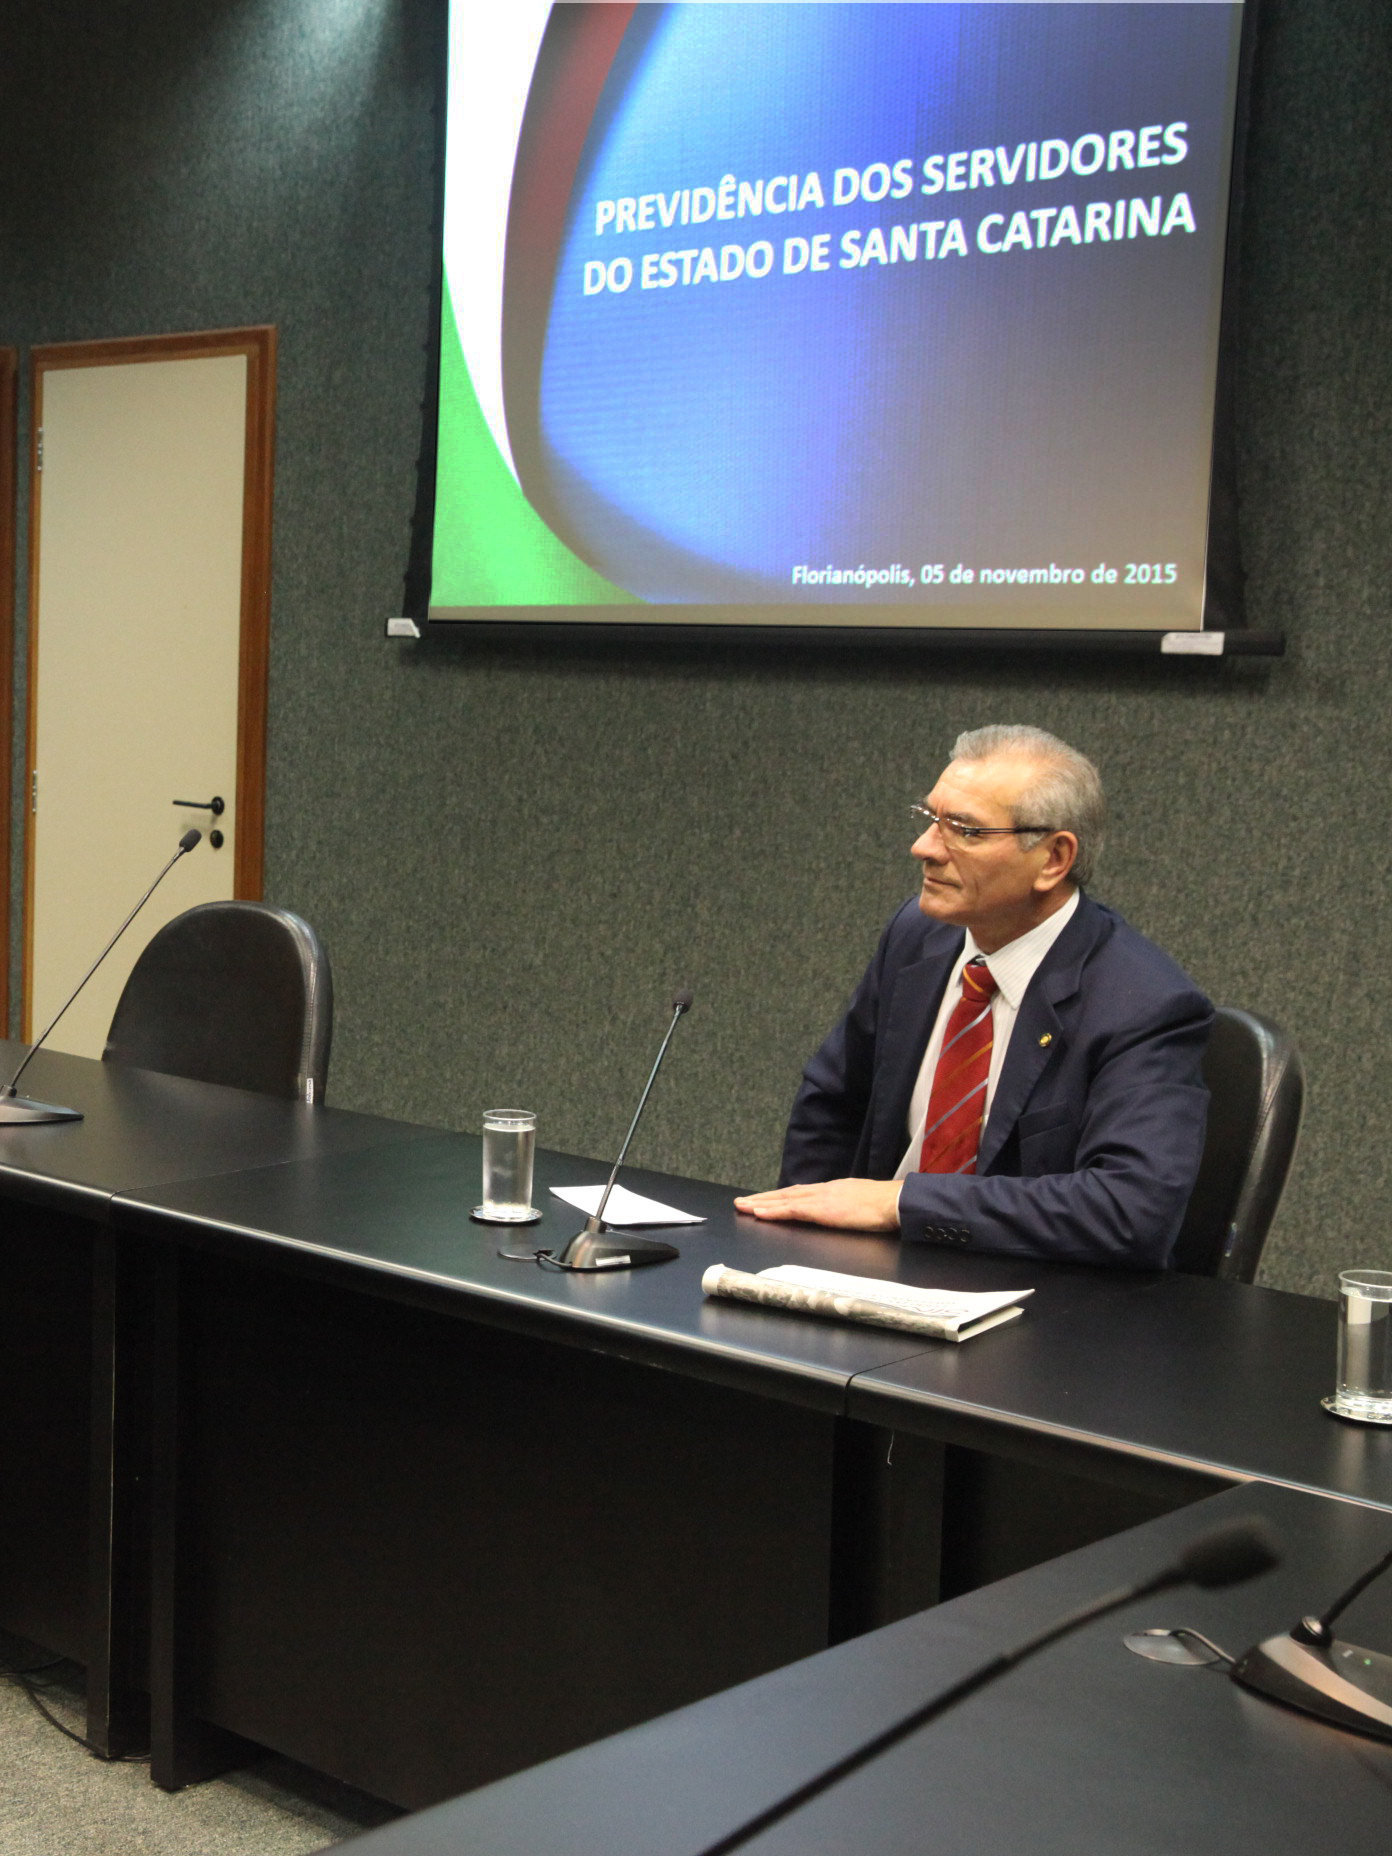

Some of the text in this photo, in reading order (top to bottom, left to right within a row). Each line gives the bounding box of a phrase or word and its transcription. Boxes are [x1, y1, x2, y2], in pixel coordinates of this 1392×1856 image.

[595, 122, 1189, 236] PREVIDÊNCIA DOS SERVIDORES
[583, 193, 1196, 296] DO ESTADO DE SANTA CATARINA
[791, 563, 1177, 588] Florianópolis, 05 de novembro de 2015
